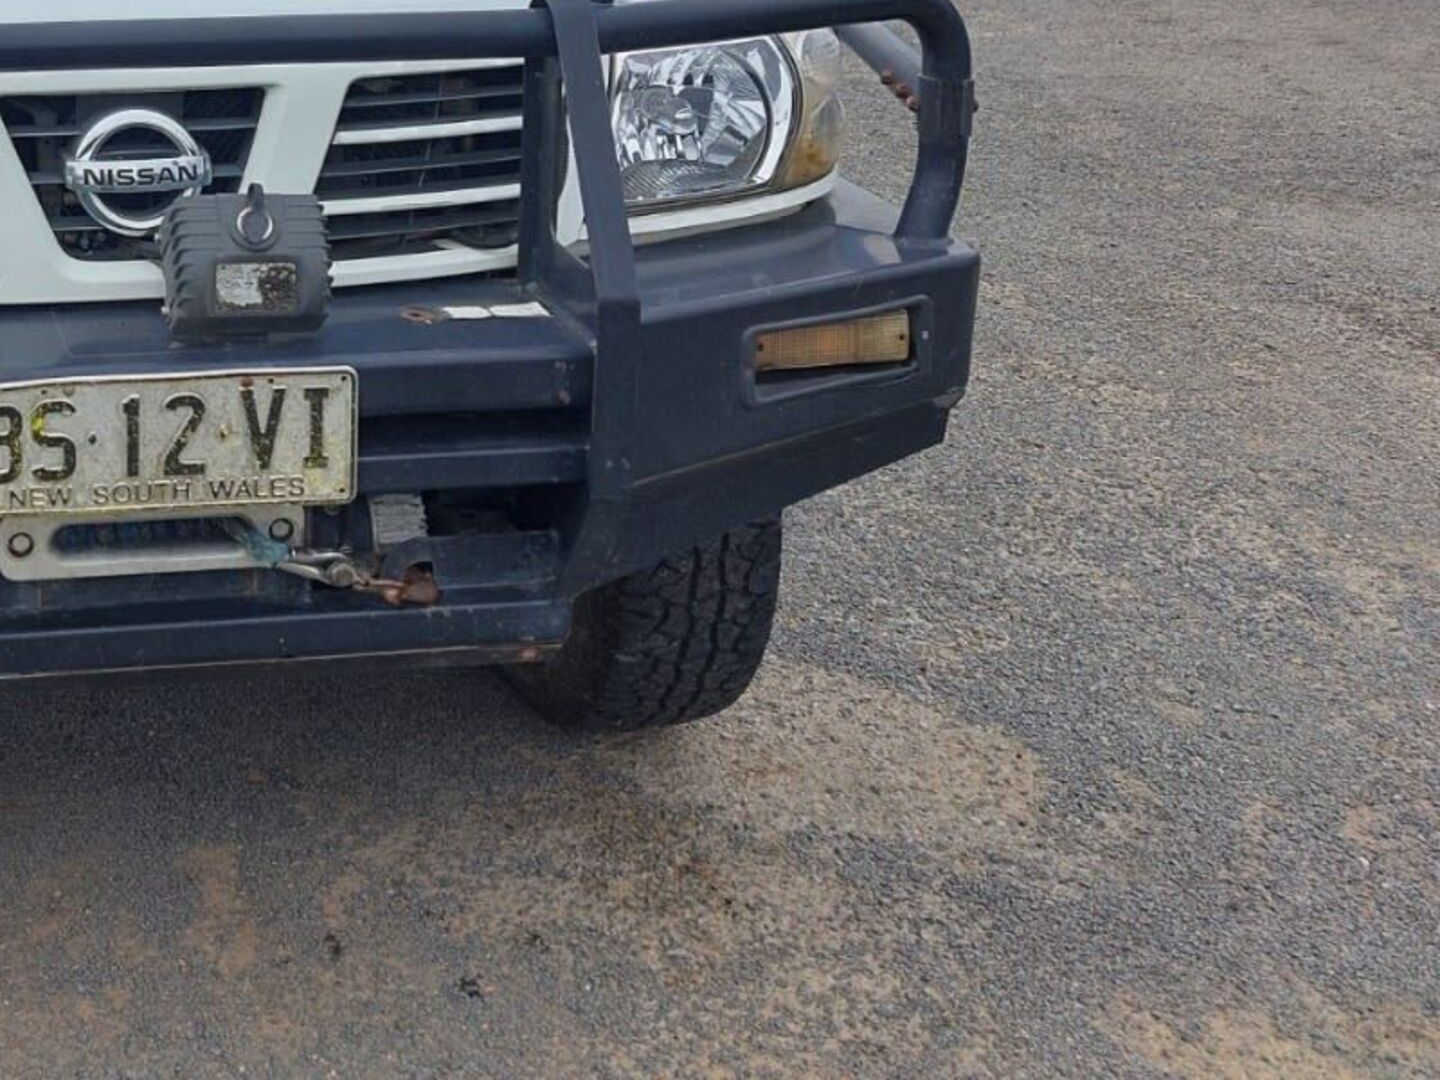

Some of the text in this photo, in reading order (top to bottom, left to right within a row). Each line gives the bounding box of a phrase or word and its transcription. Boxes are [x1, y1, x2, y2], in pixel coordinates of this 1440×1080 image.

[82, 164, 199, 187] NISSAN
[8, 475, 307, 509] NEW SOUTH WALES
